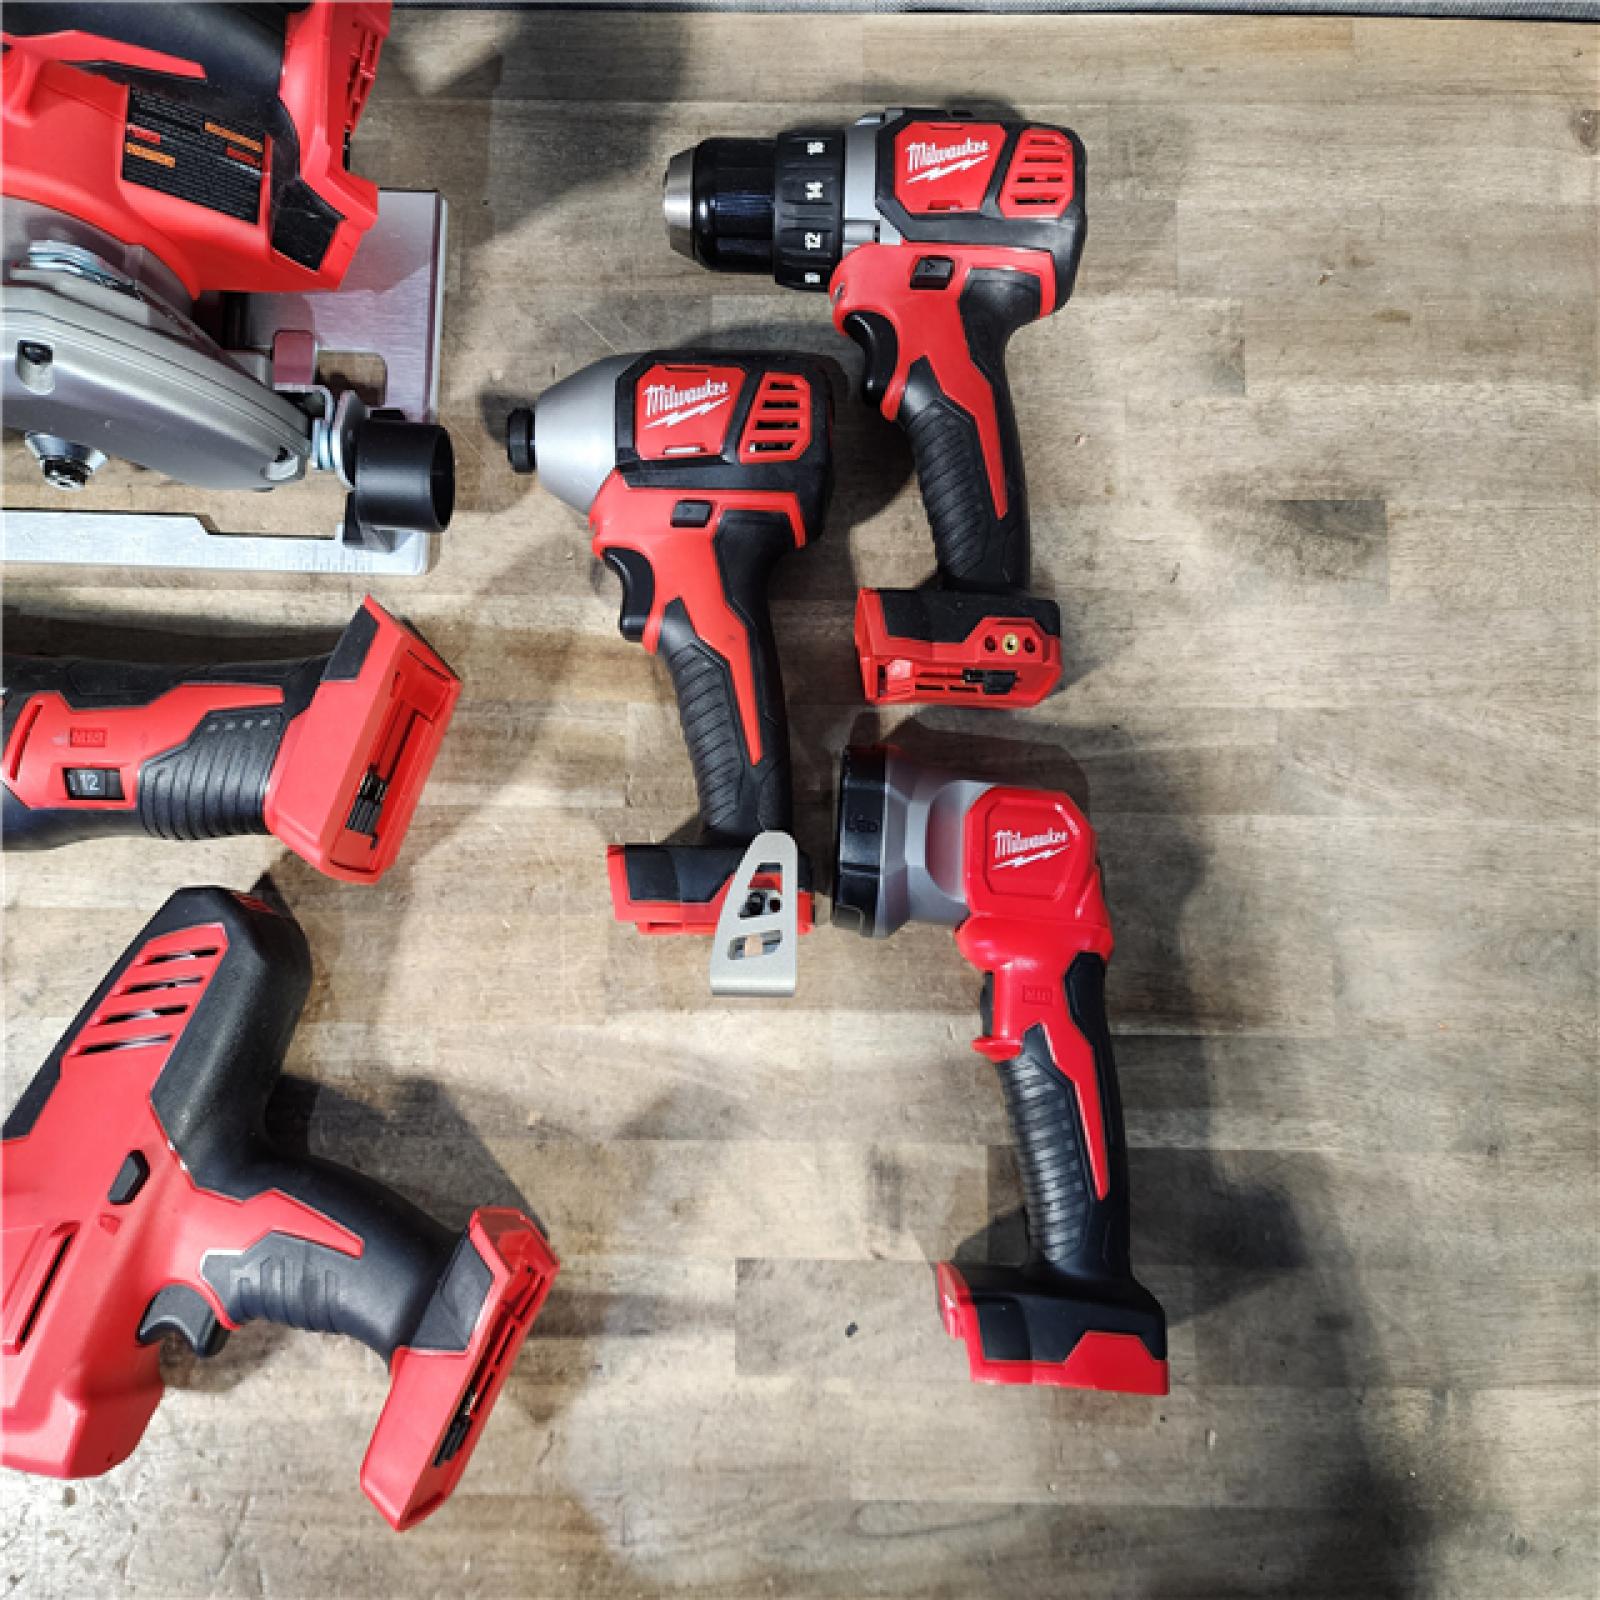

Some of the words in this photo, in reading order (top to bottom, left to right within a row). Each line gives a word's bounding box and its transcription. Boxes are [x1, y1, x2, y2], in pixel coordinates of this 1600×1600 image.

[905, 137, 989, 173] Milwaukee
[643, 378, 728, 418] Milwaukee
[80, 774, 100, 791] 12
[992, 828, 1068, 859] Milwaukee
